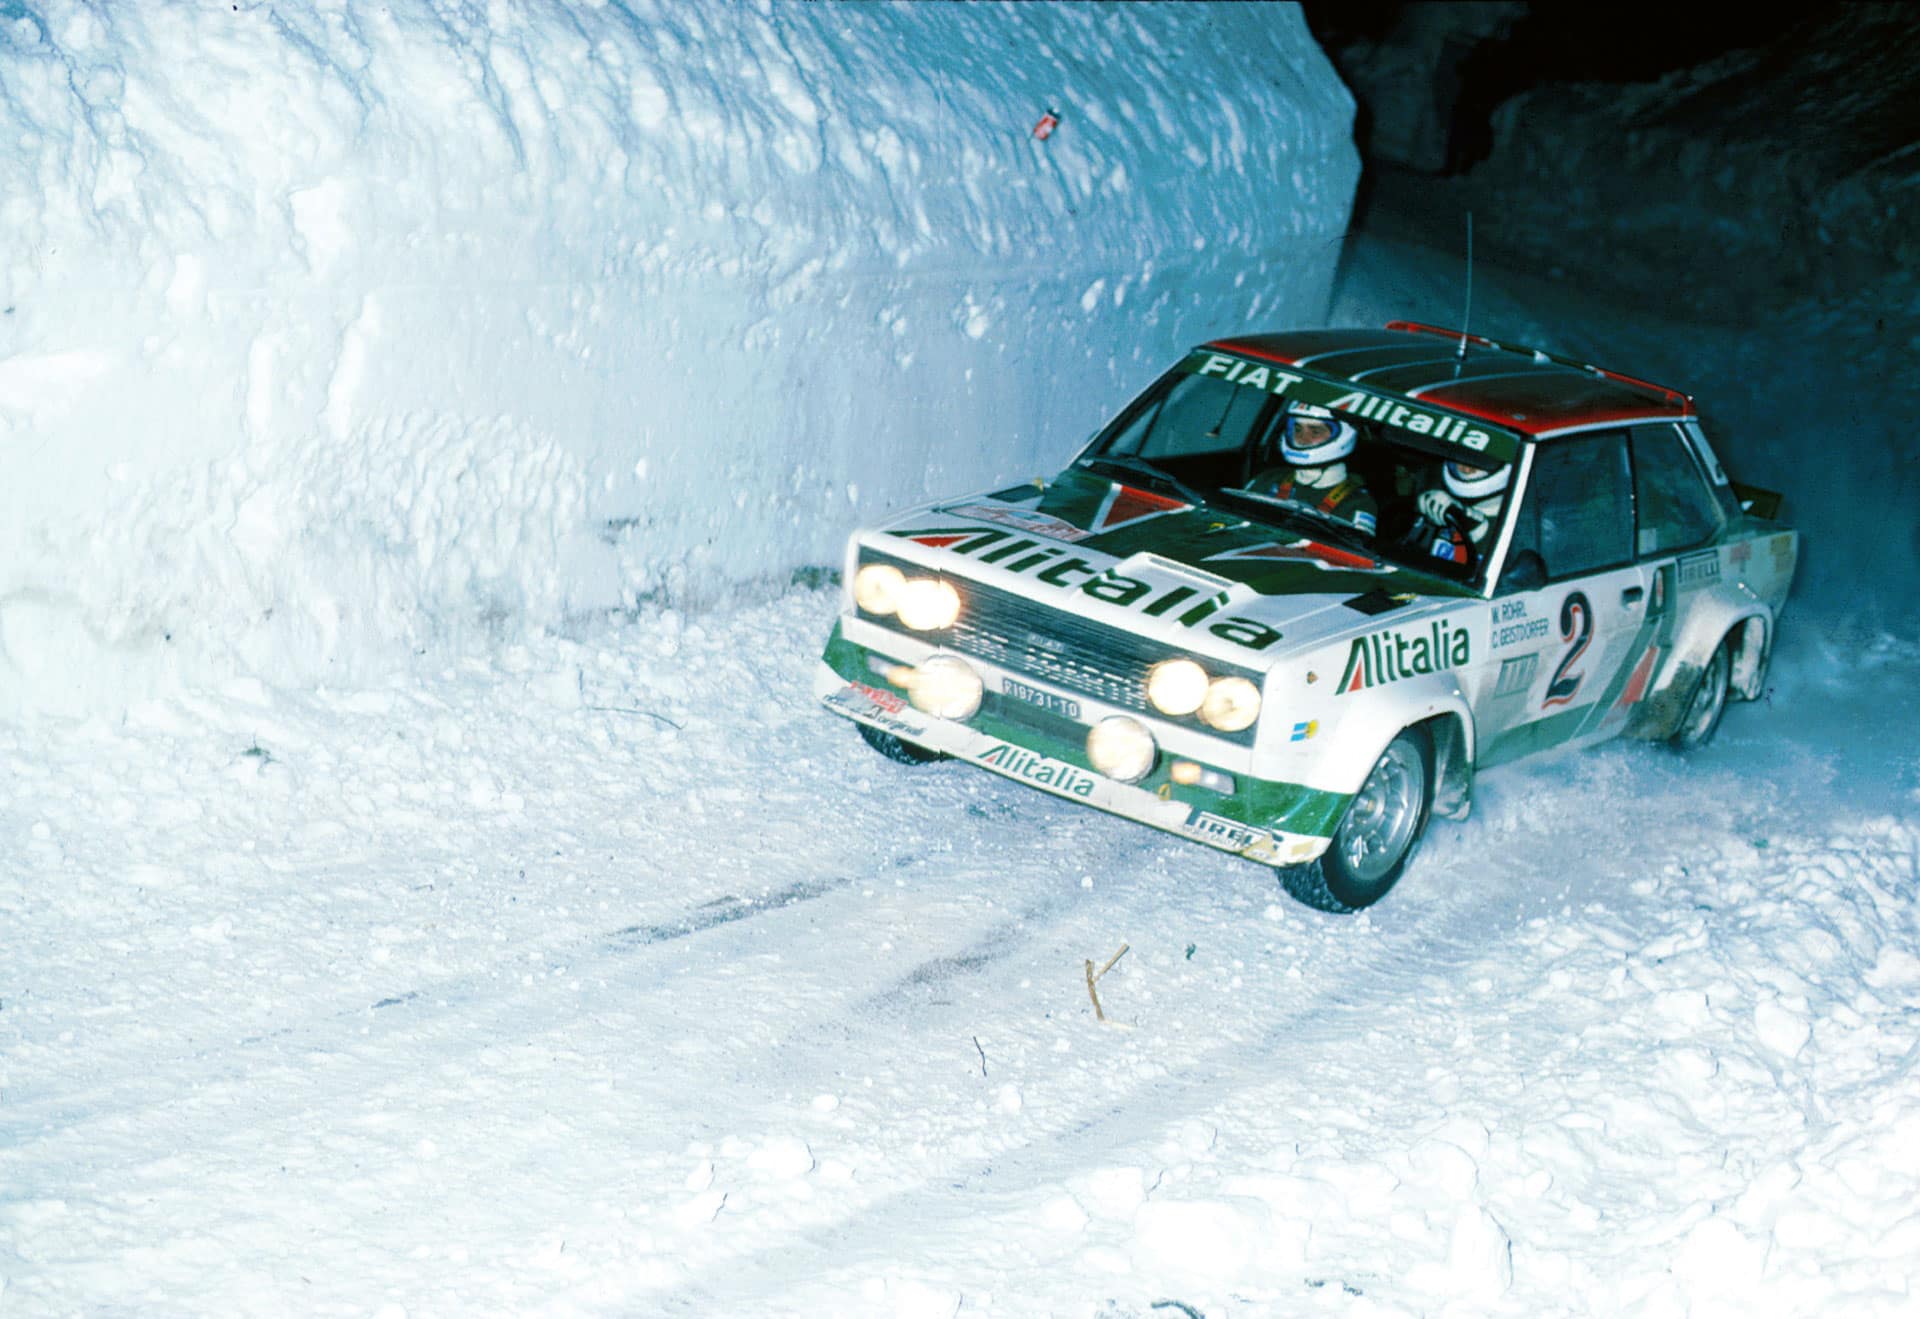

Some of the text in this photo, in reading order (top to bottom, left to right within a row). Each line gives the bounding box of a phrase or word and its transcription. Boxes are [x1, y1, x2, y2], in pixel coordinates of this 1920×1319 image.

[1199, 355, 1490, 451] FIAT Alitalia
[883, 527, 1283, 651] Alitalia
[1335, 619, 1469, 696] Alitalia
[1540, 590, 1595, 709] 2
[977, 744, 1095, 796] Alitalia
